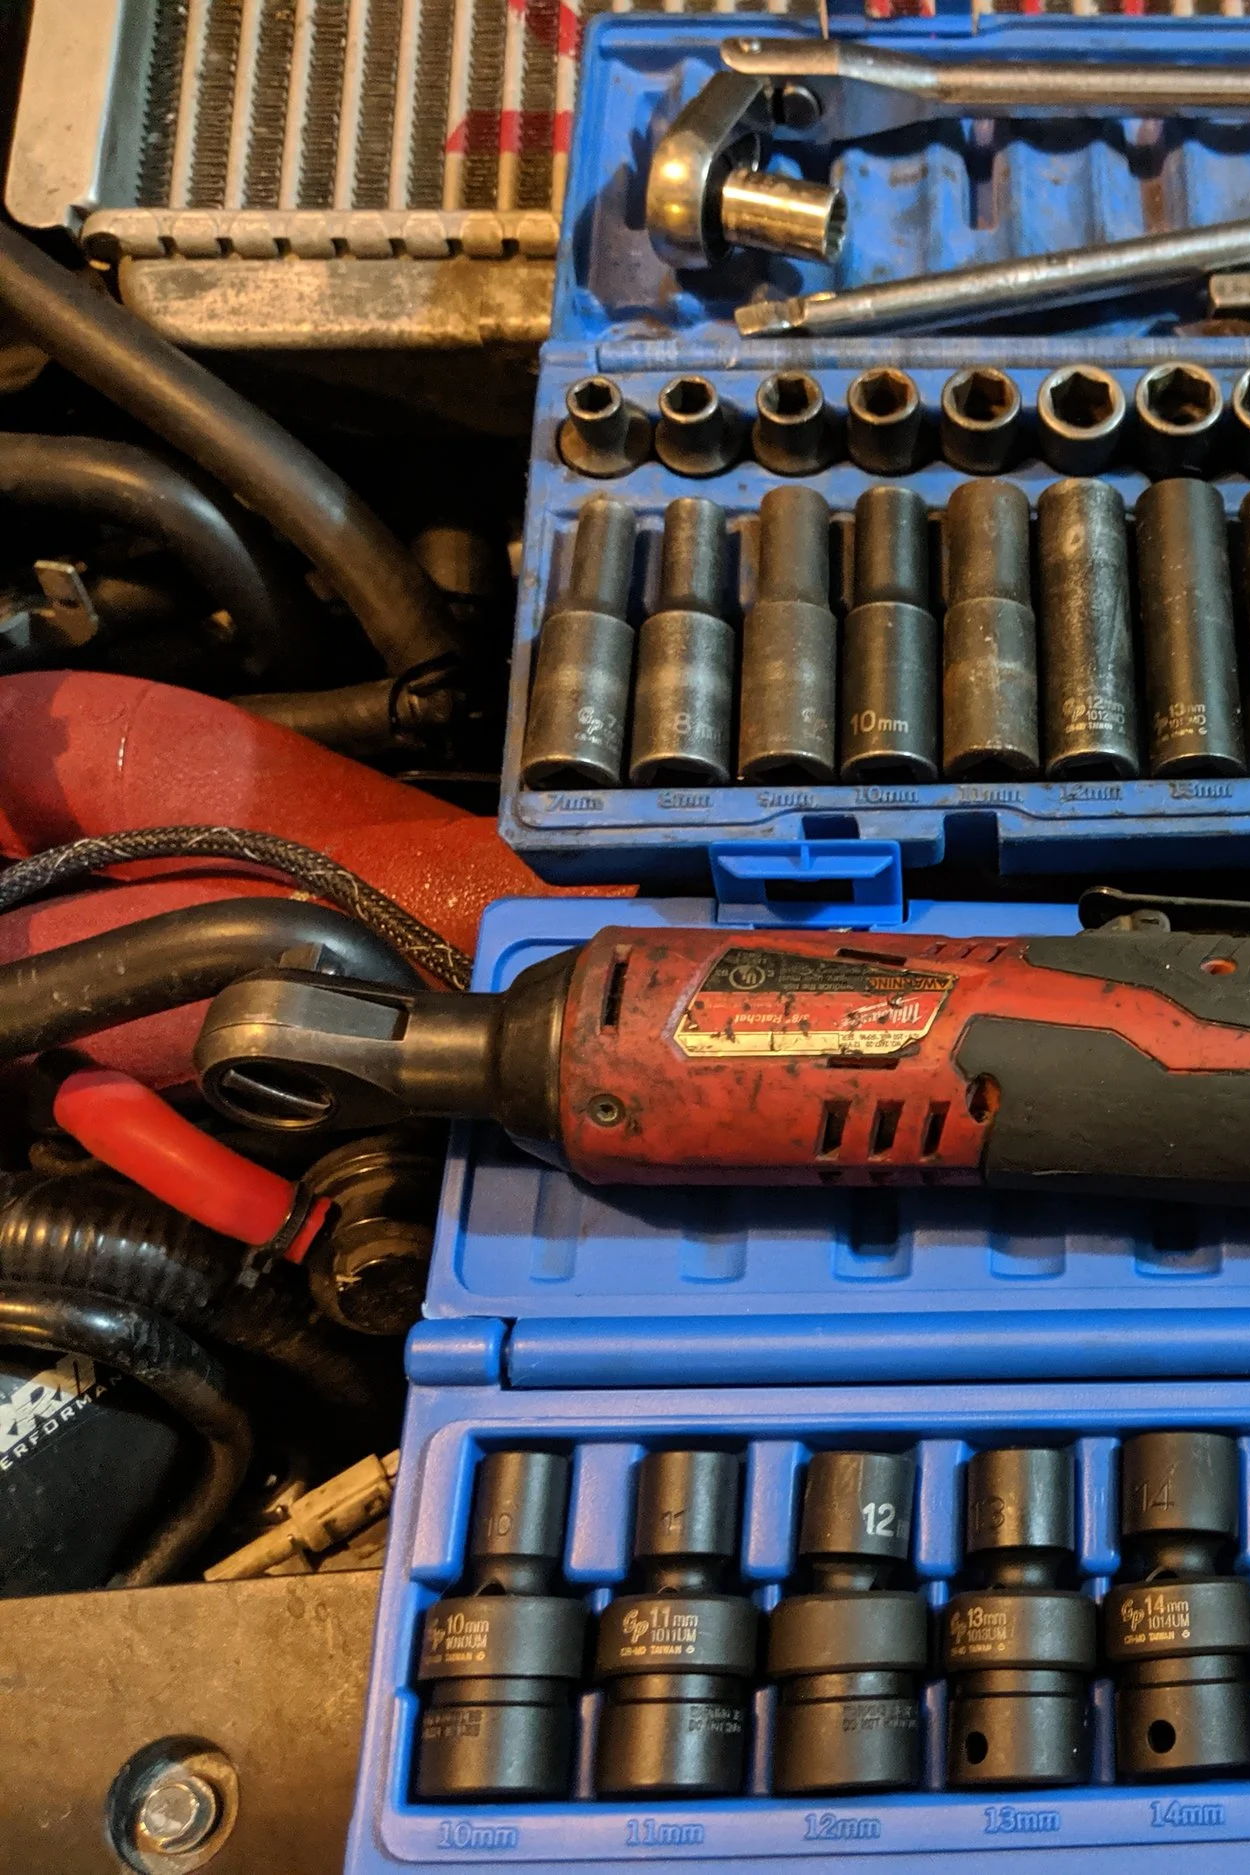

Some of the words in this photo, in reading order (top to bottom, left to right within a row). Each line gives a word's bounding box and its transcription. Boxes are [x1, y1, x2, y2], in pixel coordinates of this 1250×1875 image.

[851, 710, 909, 735] 10mm
[855, 787, 919, 804] 10mm
[1059, 784, 1123, 801] 12mm
[733, 1013, 782, 1025] Ratchet
[1135, 1481, 1174, 1512] 14
[1144, 1594, 1189, 1615] 14mm
[446, 1613, 489, 1634] 10mm
[650, 1606, 698, 1627] 11mm
[967, 1606, 1007, 1628] 13mm
[1148, 1613, 1190, 1629] 1014UM
[651, 1628, 696, 1642] 1011UM
[983, 1806, 1061, 1834] 13mm
[1150, 1800, 1225, 1826] 14mm
[437, 1819, 518, 1850] 10mm
[626, 1818, 704, 1846] 11mm
[803, 1813, 880, 1841] 12mm
